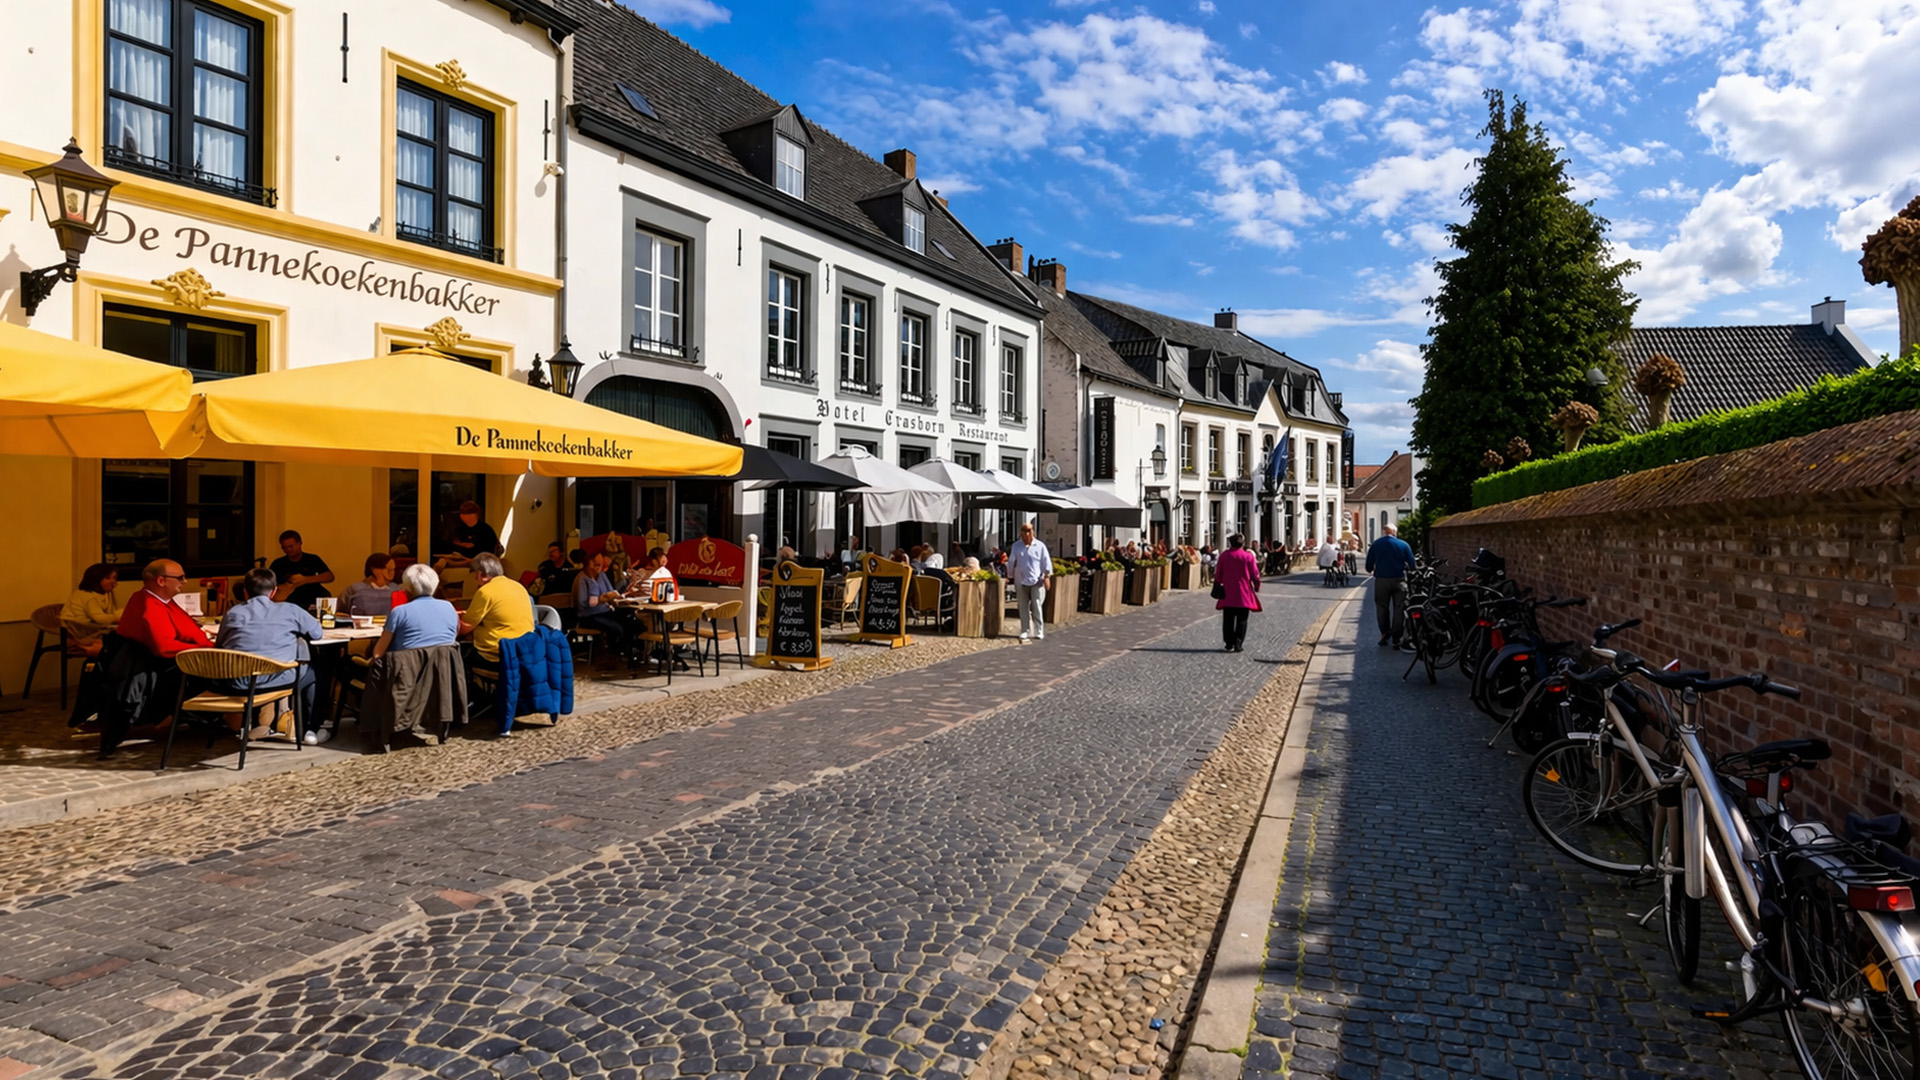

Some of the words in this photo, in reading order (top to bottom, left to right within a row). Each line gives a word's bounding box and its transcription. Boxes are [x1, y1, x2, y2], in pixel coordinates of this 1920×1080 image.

[93, 209, 160, 251] De
[174, 227, 500, 316] Pannekoekenbakker
[455, 426, 481, 447] De
